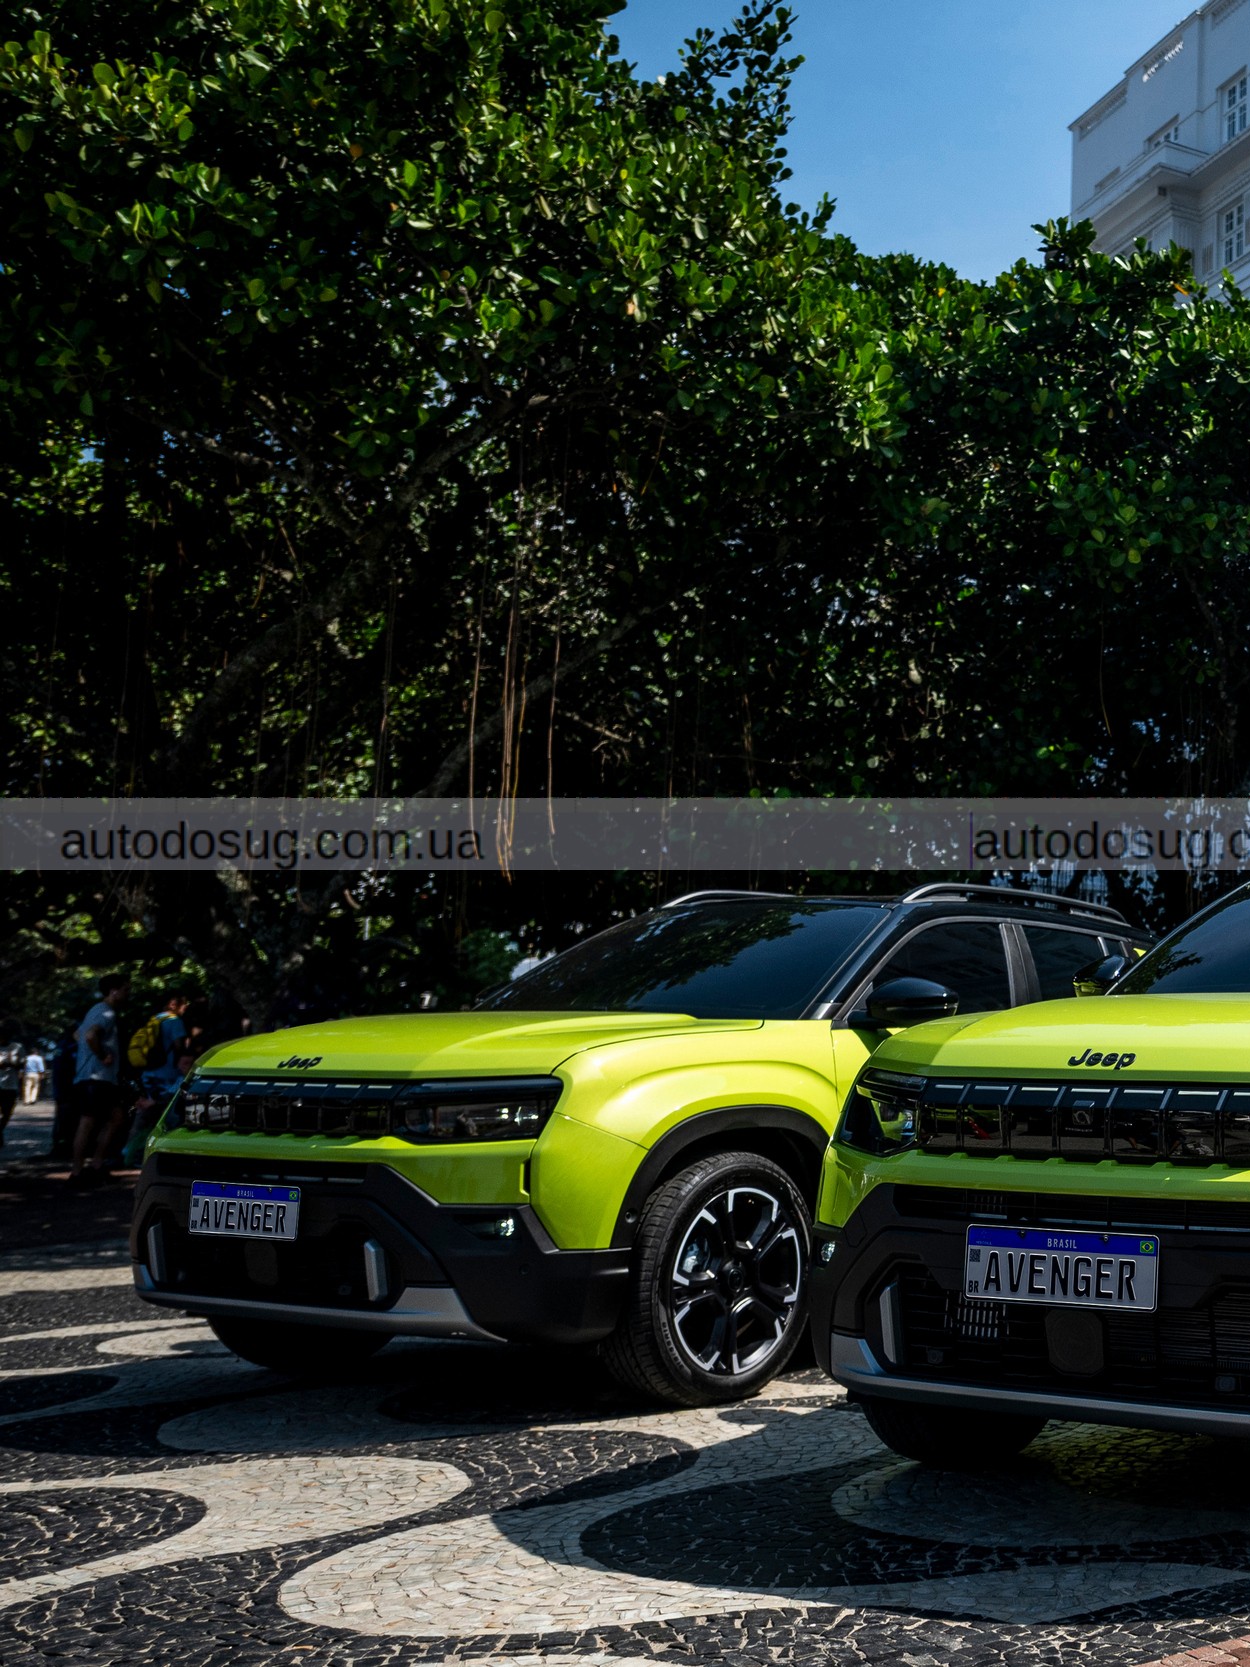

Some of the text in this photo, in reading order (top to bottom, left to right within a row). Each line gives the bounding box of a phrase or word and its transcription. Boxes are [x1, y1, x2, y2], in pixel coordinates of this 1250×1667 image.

[277, 1055, 323, 1070] Jeep
[1067, 1048, 1136, 1070] Jeep
[236, 1190, 255, 1198] BRASIL
[200, 1199, 287, 1233] AVENGER
[1047, 1238, 1078, 1249] BRASIL
[983, 1250, 1137, 1301] AVENGER
[968, 1280, 979, 1293] BR
